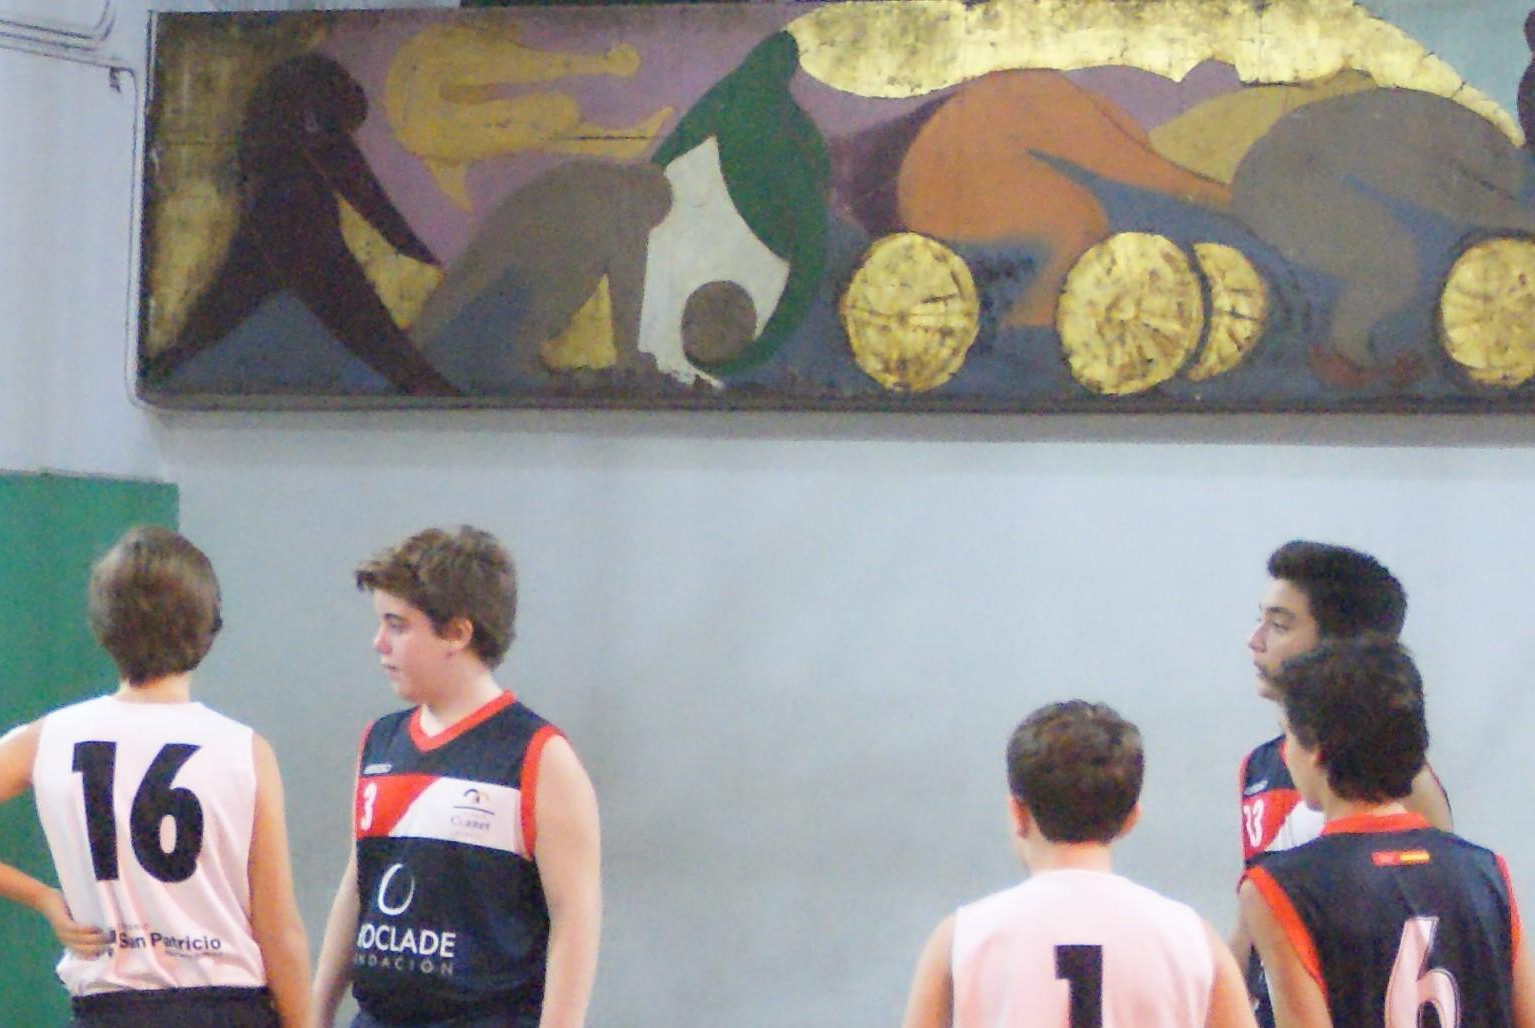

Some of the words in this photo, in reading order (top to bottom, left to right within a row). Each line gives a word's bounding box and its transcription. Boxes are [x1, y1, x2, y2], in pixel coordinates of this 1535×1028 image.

[72, 740, 204, 883] 16
[119, 932, 147, 949] San
[150, 931, 222, 951] Patricio
[357, 923, 457, 958] OCLADE
